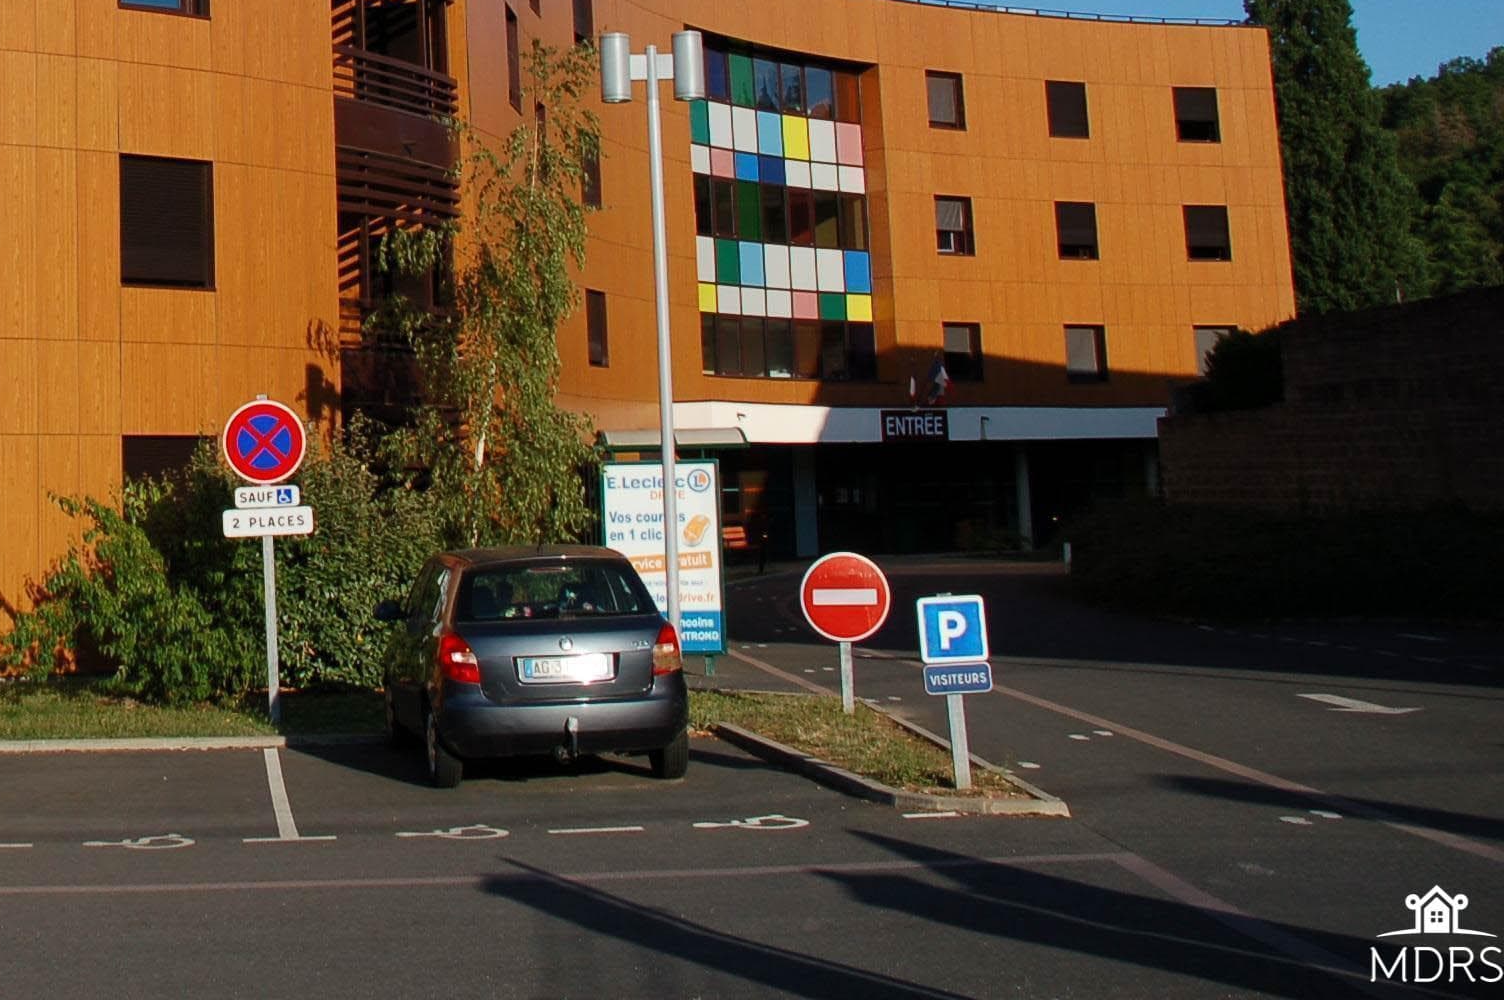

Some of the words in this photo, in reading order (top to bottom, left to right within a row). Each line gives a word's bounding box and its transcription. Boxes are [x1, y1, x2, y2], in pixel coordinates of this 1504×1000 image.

[886, 413, 944, 436] ENTRÉE
[607, 476, 685, 489] E.Leclec
[239, 491, 273, 503] SAUF
[232, 518, 240, 529] 2
[249, 515, 304, 528] PLACES
[609, 511, 632, 523] Vos
[635, 512, 686, 522] cours
[610, 532, 624, 541] en
[630, 529, 635, 540] 1
[640, 528, 663, 540] clic
[633, 558, 662, 569] rvice
[678, 553, 707, 566] atuit
[938, 610, 967, 650] P
[929, 672, 987, 686] VISITEURS
